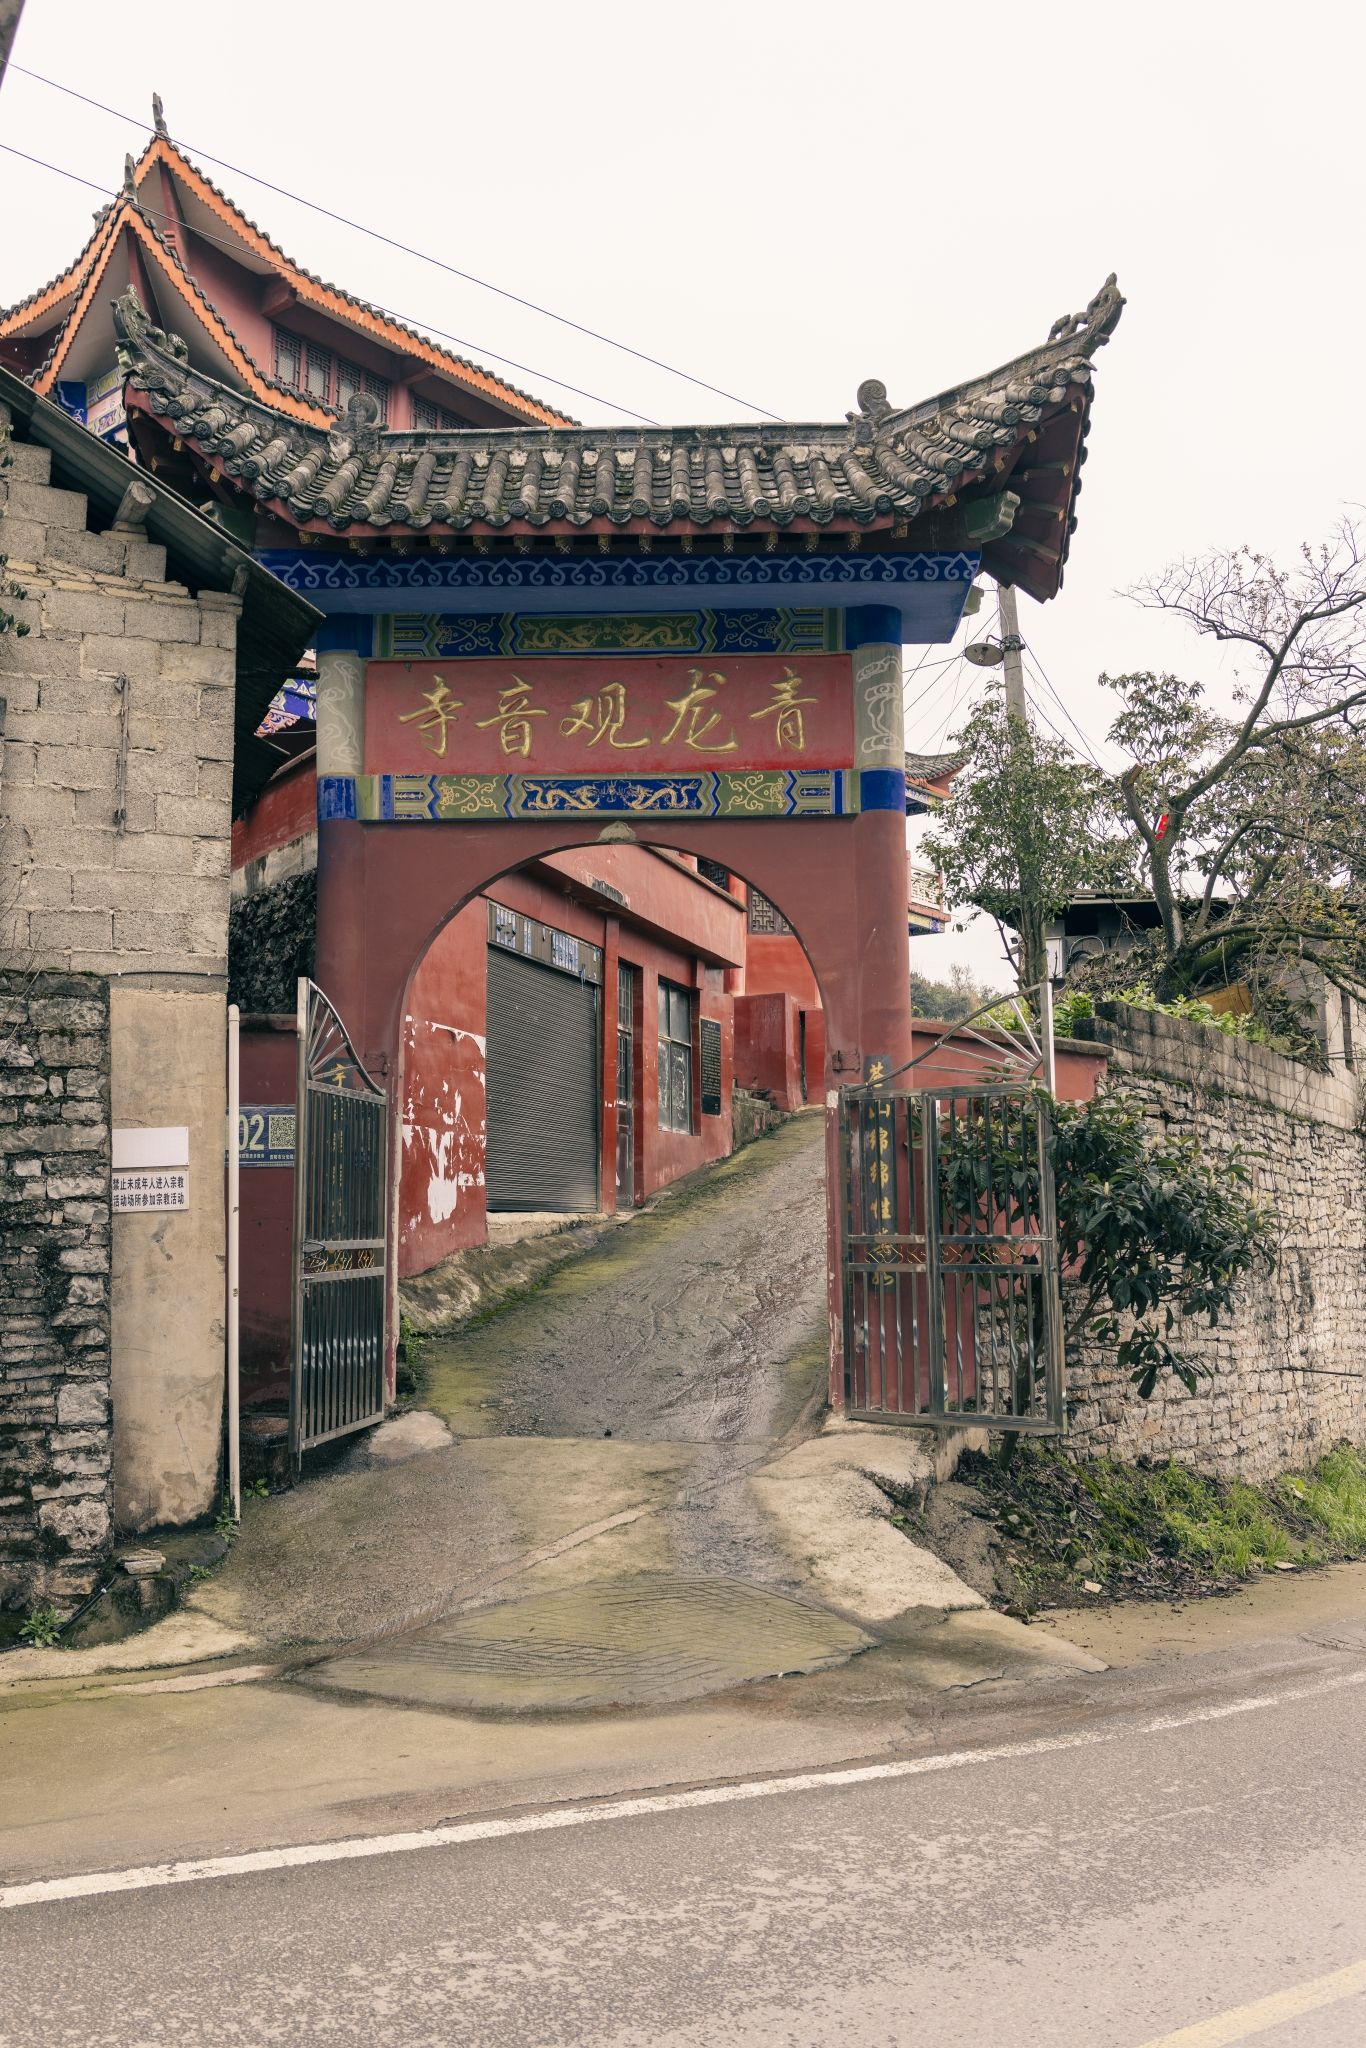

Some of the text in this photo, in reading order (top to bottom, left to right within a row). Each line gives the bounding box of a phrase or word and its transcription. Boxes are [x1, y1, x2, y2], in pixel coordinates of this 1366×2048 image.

[400, 664, 818, 760] 青龙观音寺
[225, 1114, 265, 1151] 02
[112, 1175, 184, 1191] 禁止未成年人进入宗教
[112, 1192, 185, 1208] 活动场所参加宗教活动
